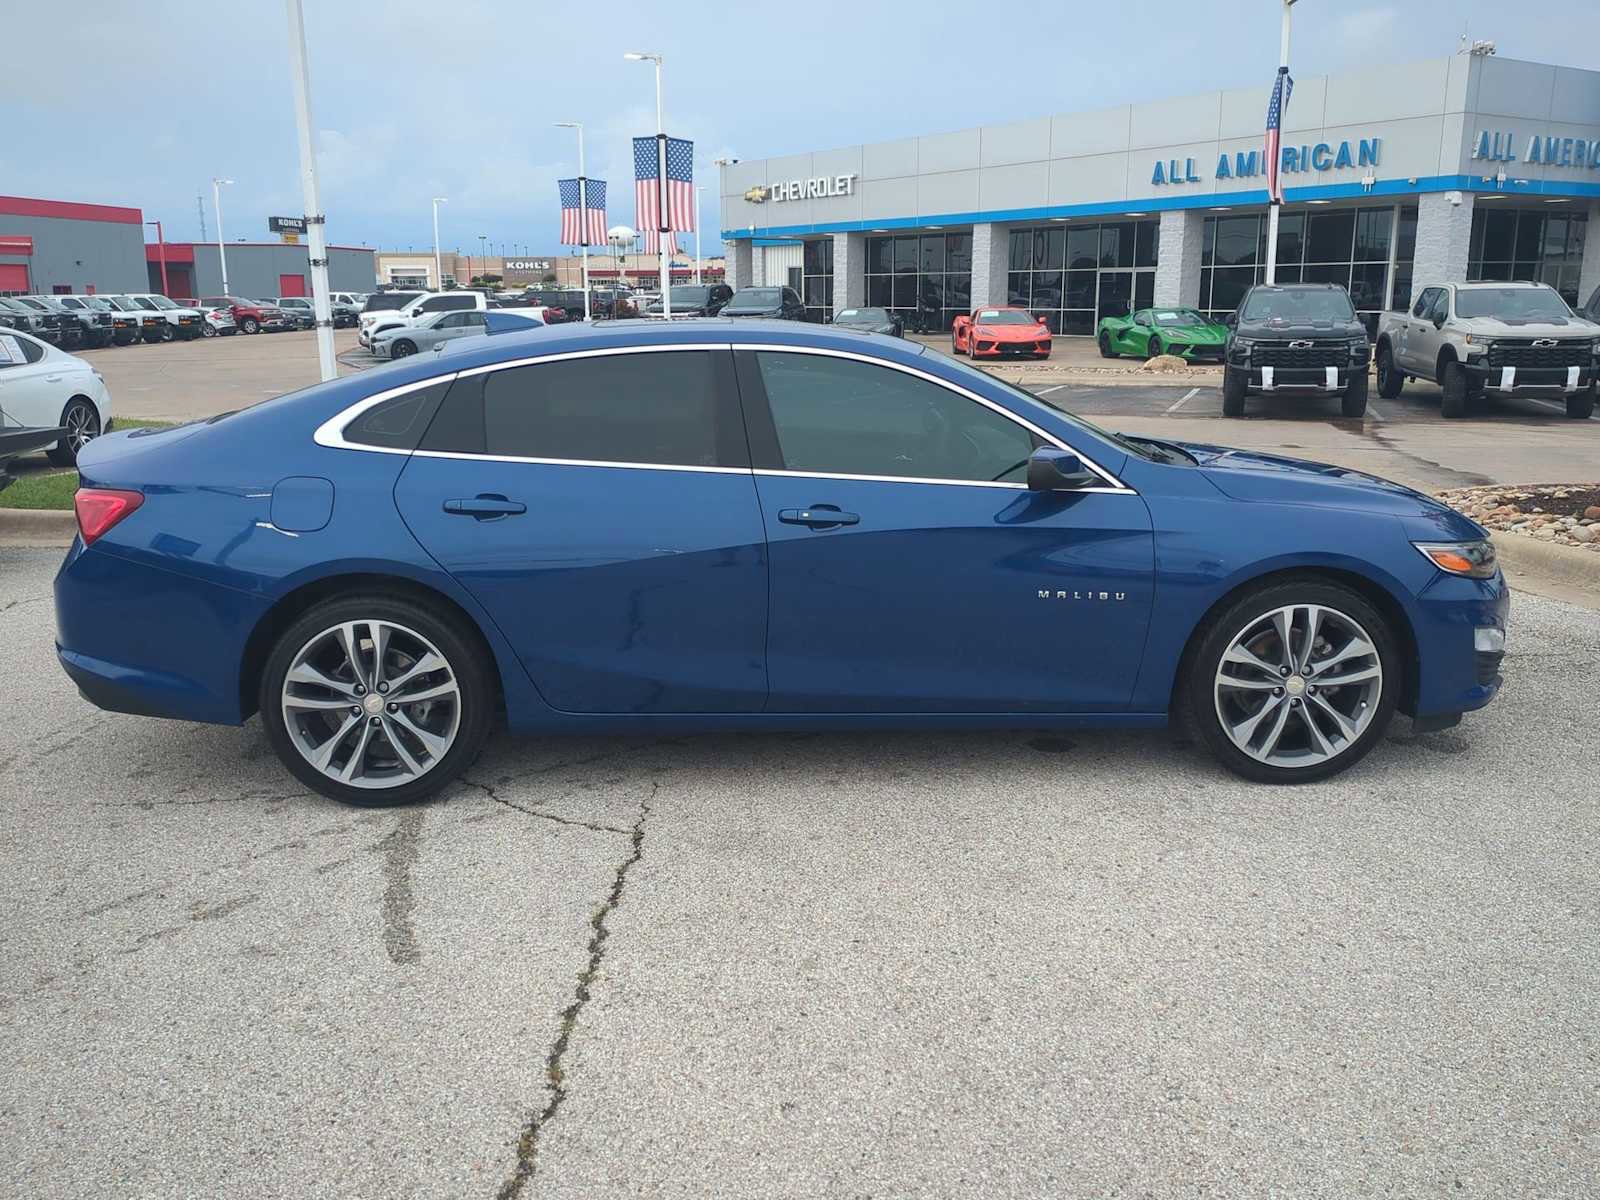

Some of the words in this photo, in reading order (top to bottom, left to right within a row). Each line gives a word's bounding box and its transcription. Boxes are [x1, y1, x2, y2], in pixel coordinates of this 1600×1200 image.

[1472, 131, 1516, 160] ALL
[1151, 158, 1200, 185] ALL
[771, 174, 857, 201] CHEVROLET
[506, 261, 550, 270] KOHL'S
[1038, 590, 1125, 601] MALIBU
